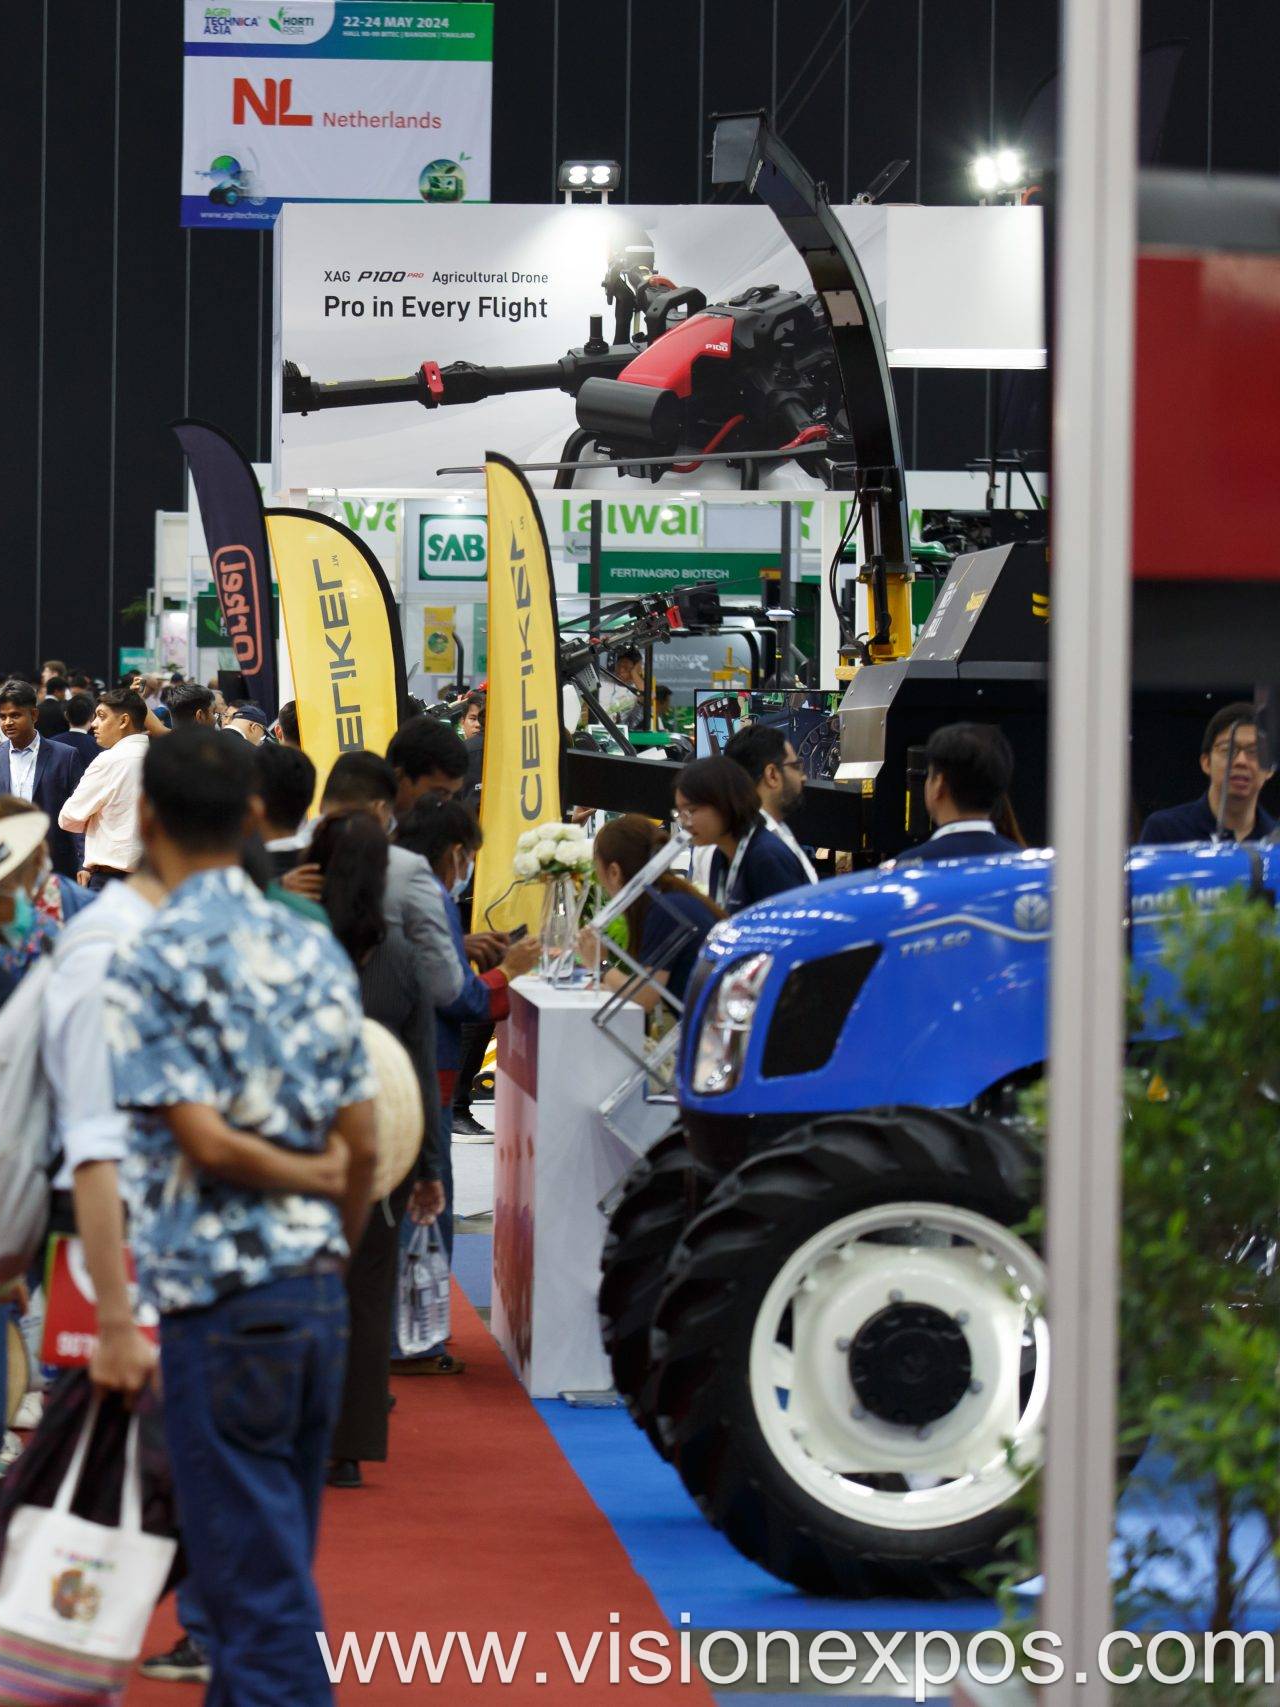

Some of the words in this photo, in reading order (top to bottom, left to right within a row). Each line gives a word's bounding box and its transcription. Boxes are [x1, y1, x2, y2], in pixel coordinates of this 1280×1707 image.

[343, 16, 381, 27] 22-24
[384, 17, 413, 28] MAY
[416, 18, 449, 28] 2024
[204, 26, 231, 35] ASIA
[232, 78, 313, 127] NL
[323, 111, 442, 129] Netherlands
[324, 271, 351, 282] XAG
[432, 271, 508, 285] Agricultural
[511, 272, 549, 283] Drone
[324, 296, 365, 318] Pro
[373, 296, 393, 317] in
[402, 296, 470, 322] Every
[479, 296, 548, 322] Flight
[427, 533, 486, 561] SAB
[610, 568, 680, 579] FERTINAGRO
[682, 569, 730, 579] BIOTECH
